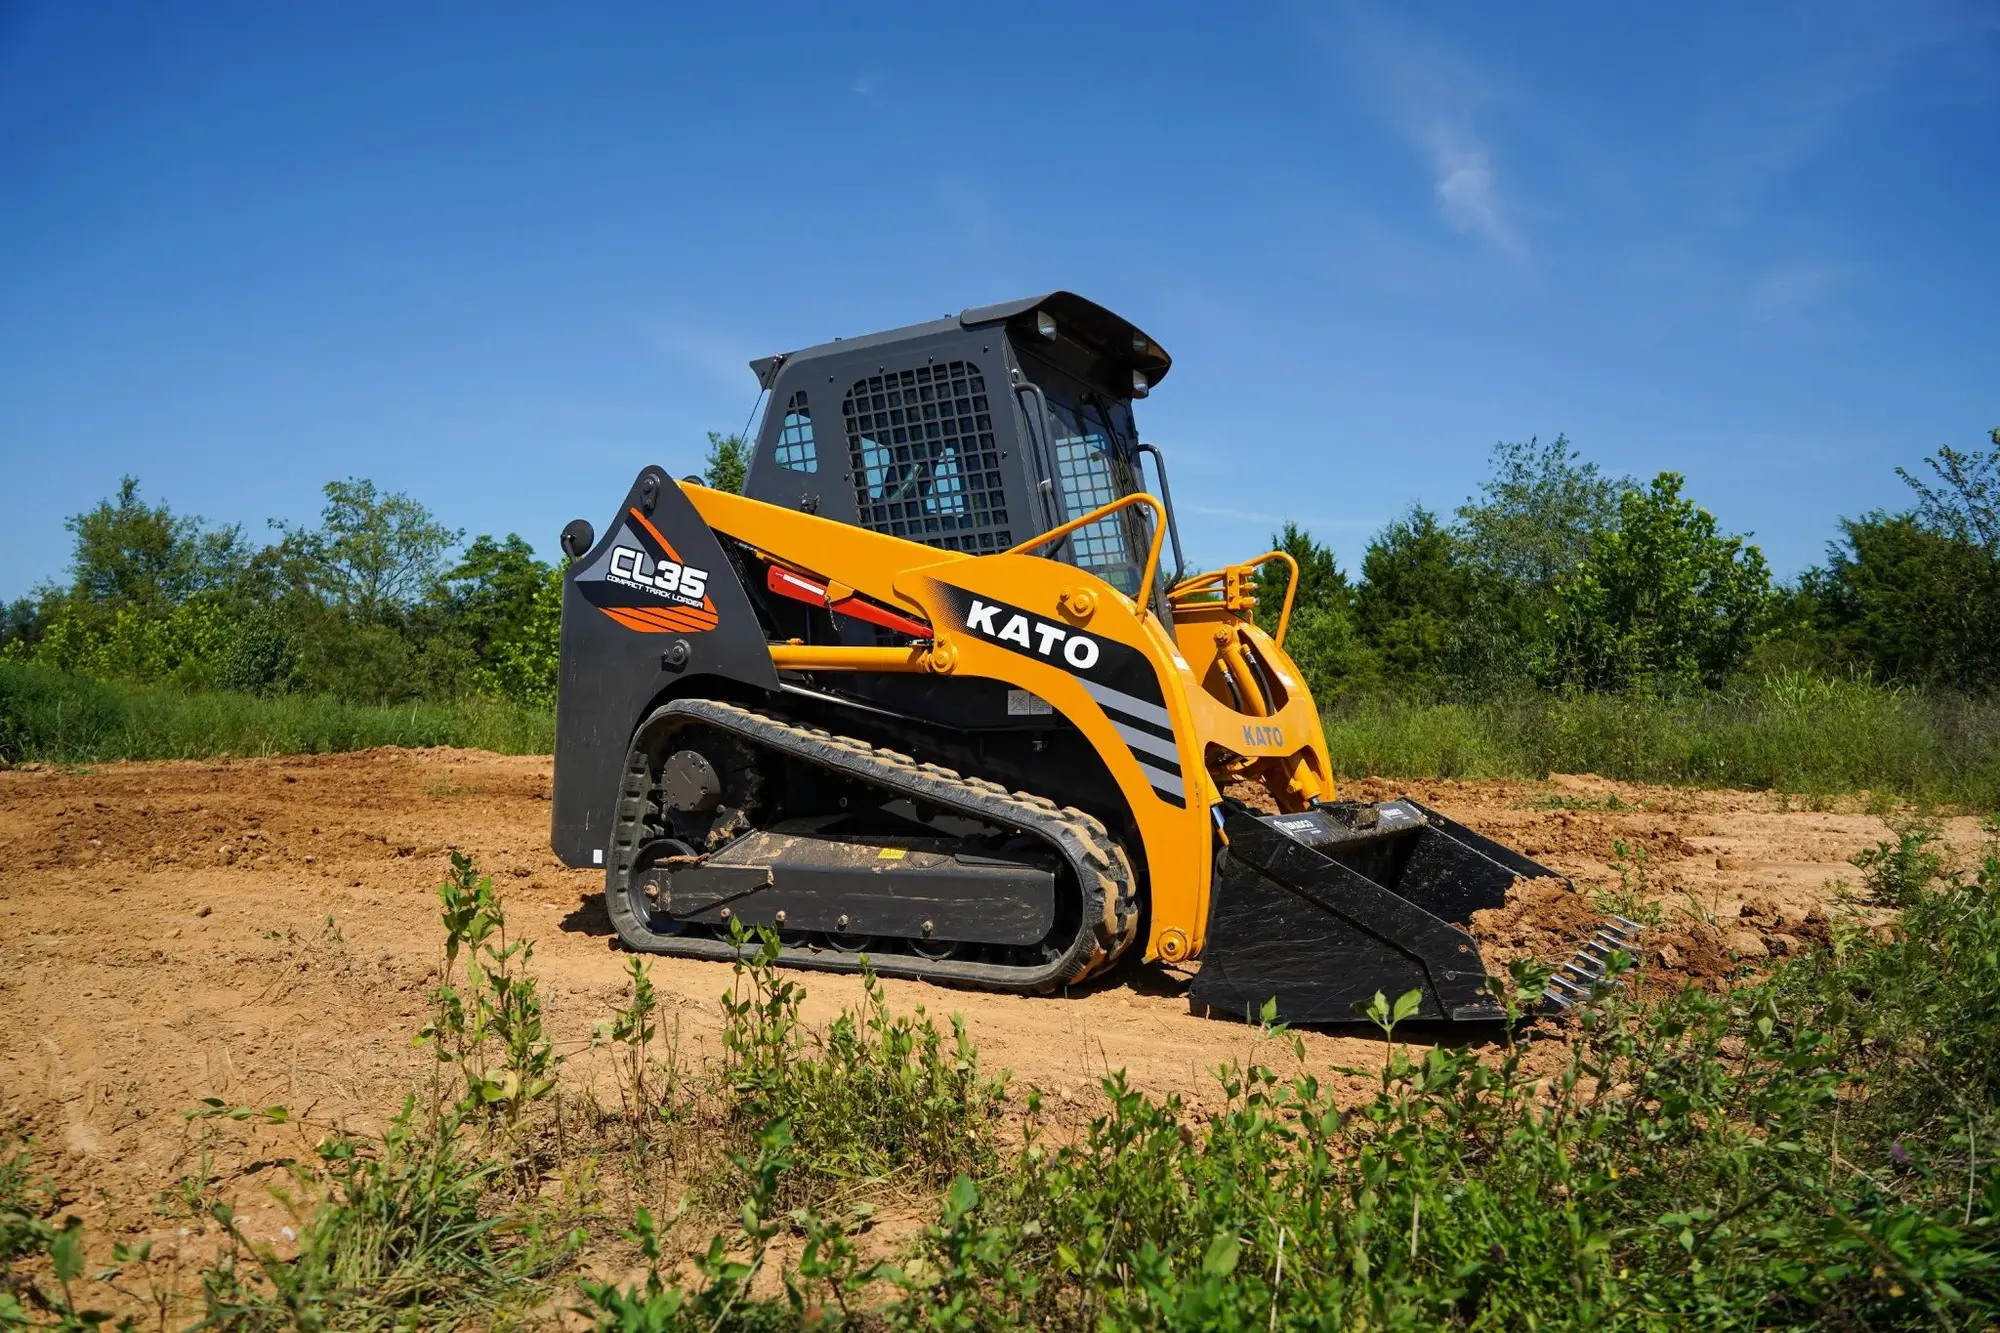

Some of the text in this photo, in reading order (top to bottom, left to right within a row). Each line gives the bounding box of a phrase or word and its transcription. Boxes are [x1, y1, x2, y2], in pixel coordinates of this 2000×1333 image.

[606, 574, 703, 609] COMPACT TRACK LOADER
[610, 547, 708, 599] CL35
[966, 600, 1099, 669] KATO
[1242, 725, 1284, 747] KATO
